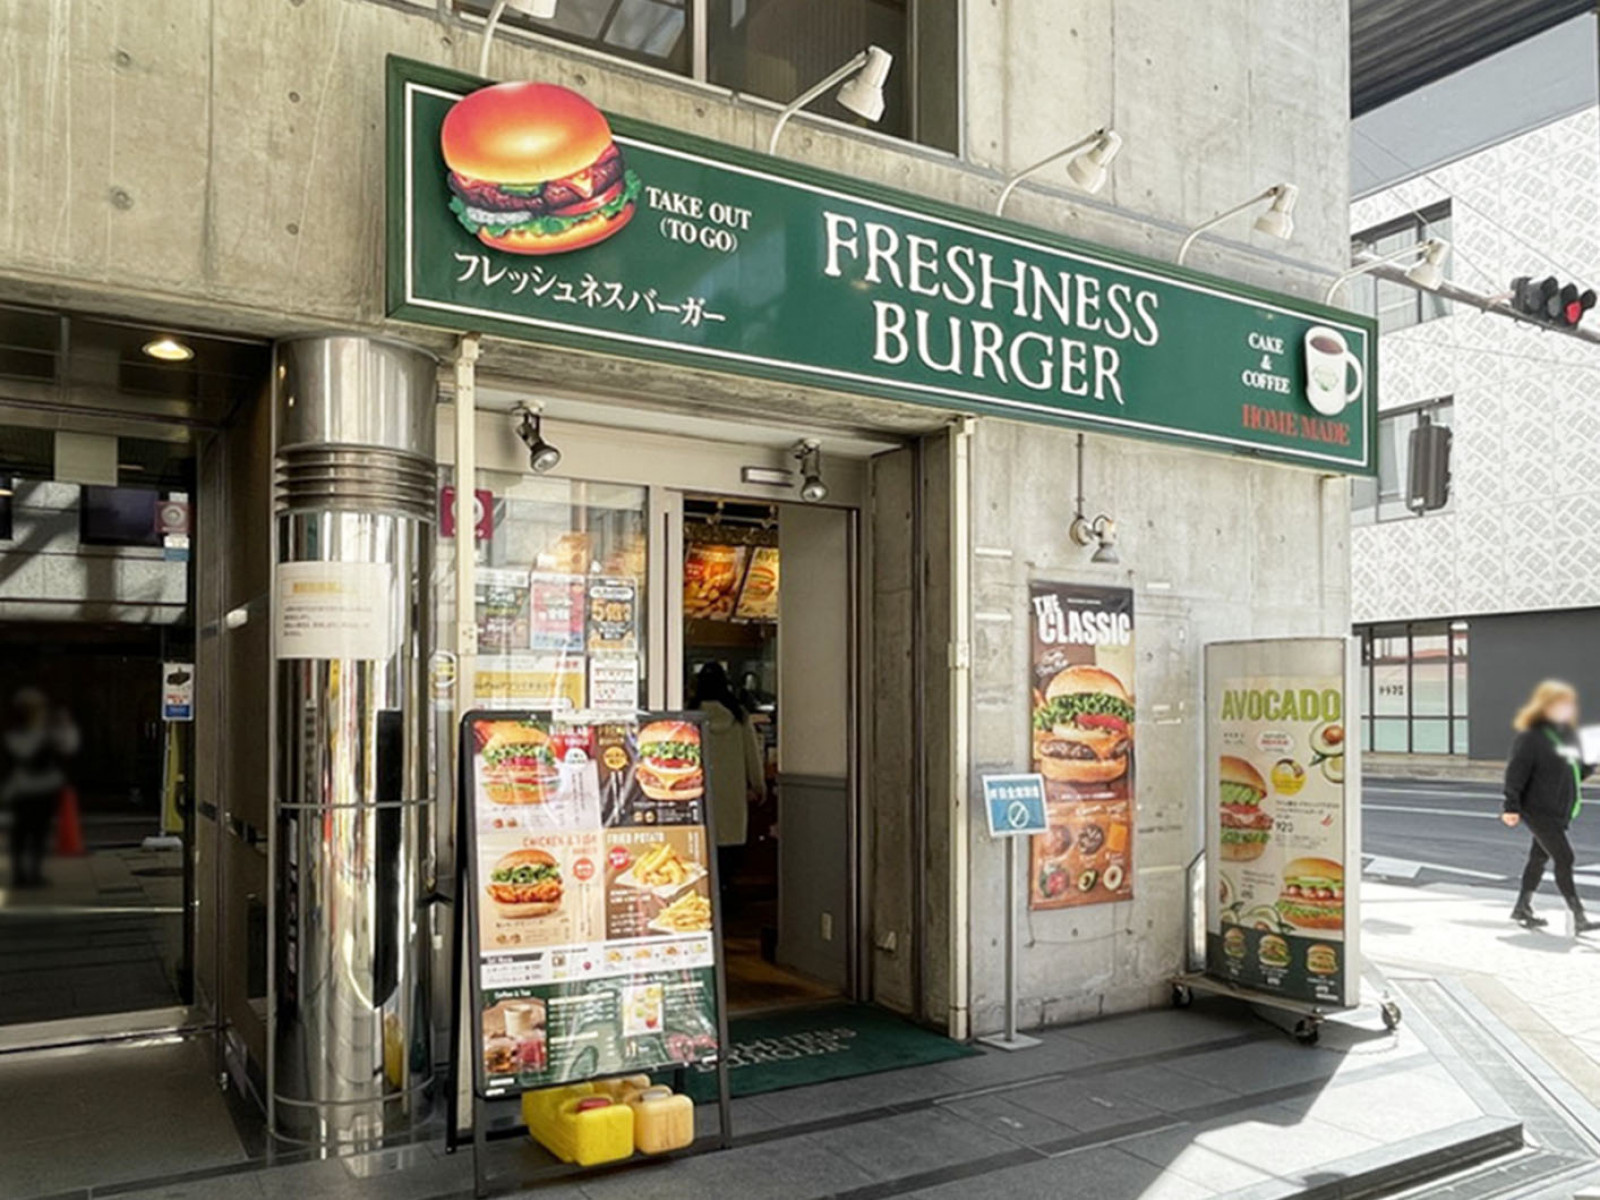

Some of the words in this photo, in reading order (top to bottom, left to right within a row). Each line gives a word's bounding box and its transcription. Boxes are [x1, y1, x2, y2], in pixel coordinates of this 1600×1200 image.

[645, 185, 703, 219] TAKE
[709, 202, 752, 230] OUT
[454, 252, 726, 328] フレッシュネスバーガー
[823, 211, 1159, 346] FRESHNESS
[873, 300, 1124, 405] BURGER
[1248, 332, 1285, 354] CAKE
[1260, 355, 1272, 370] &
[1242, 370, 1291, 394] COFFEE
[1242, 403, 1297, 436] HOME
[1302, 415, 1351, 446] MADE
[1033, 594, 1061, 615] THE
[1038, 610, 1131, 646] CLASSIC
[1221, 688, 1341, 722] AVOCADO
